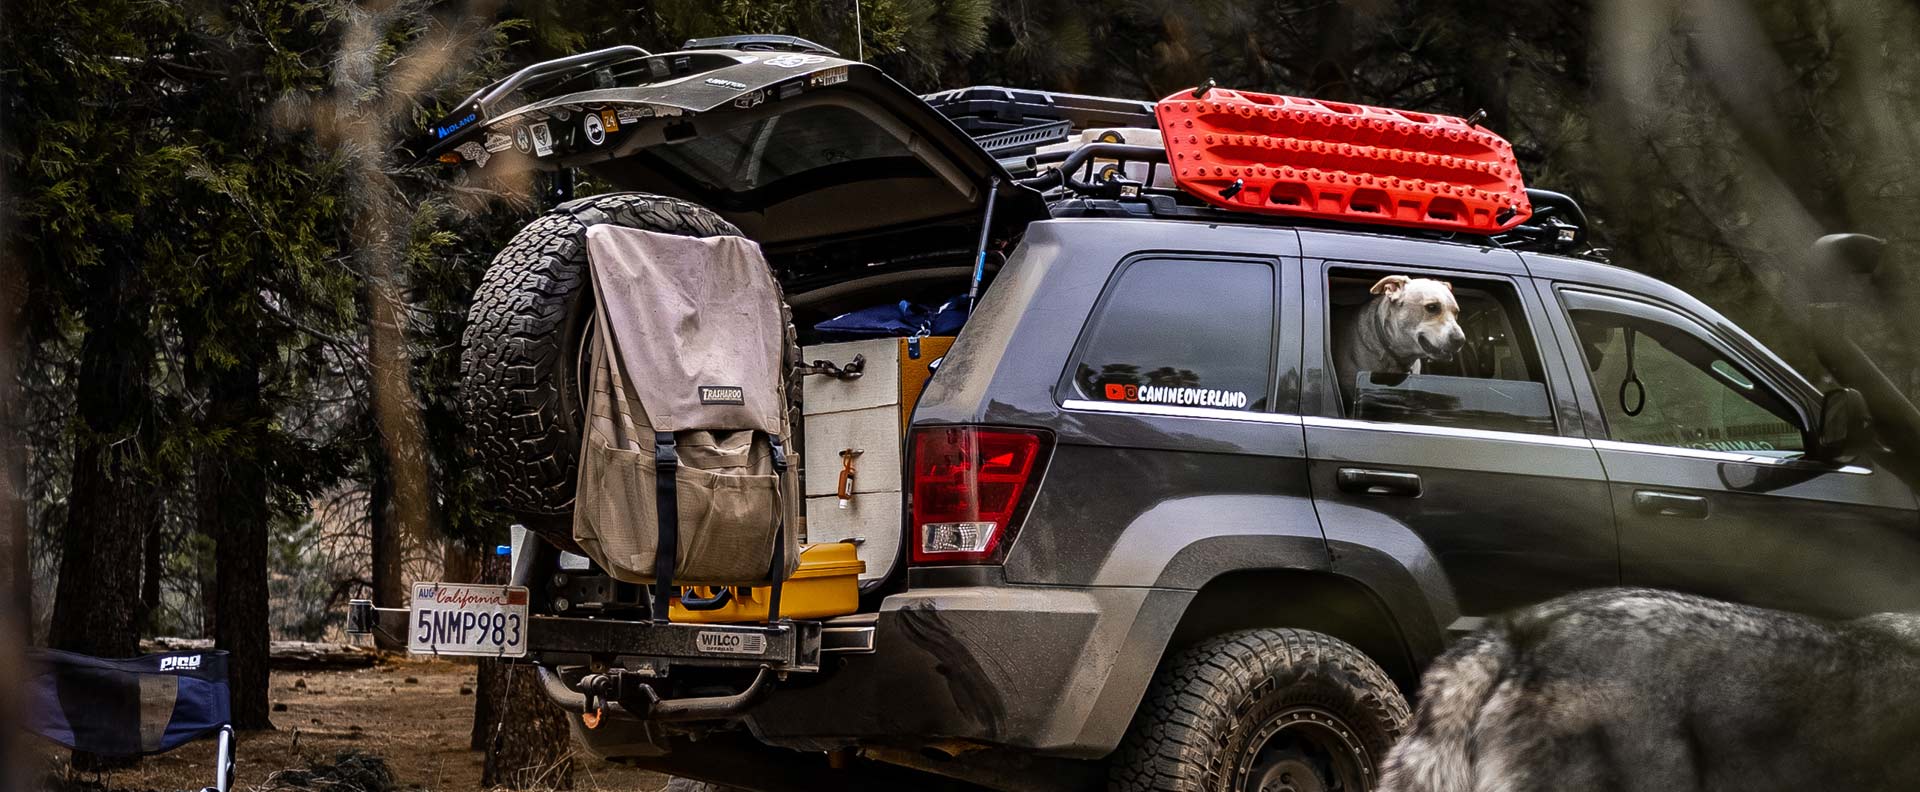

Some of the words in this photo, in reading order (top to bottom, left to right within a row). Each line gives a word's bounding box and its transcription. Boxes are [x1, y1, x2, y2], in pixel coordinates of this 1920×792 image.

[437, 113, 476, 139] MIDLAND
[702, 388, 742, 400] TRASHAROO
[1138, 385, 1247, 408] CANINEOVERLAND
[418, 588, 434, 598] AUG
[437, 587, 505, 609] California
[418, 609, 520, 647] 5NMP983
[701, 634, 740, 646] WILCO
